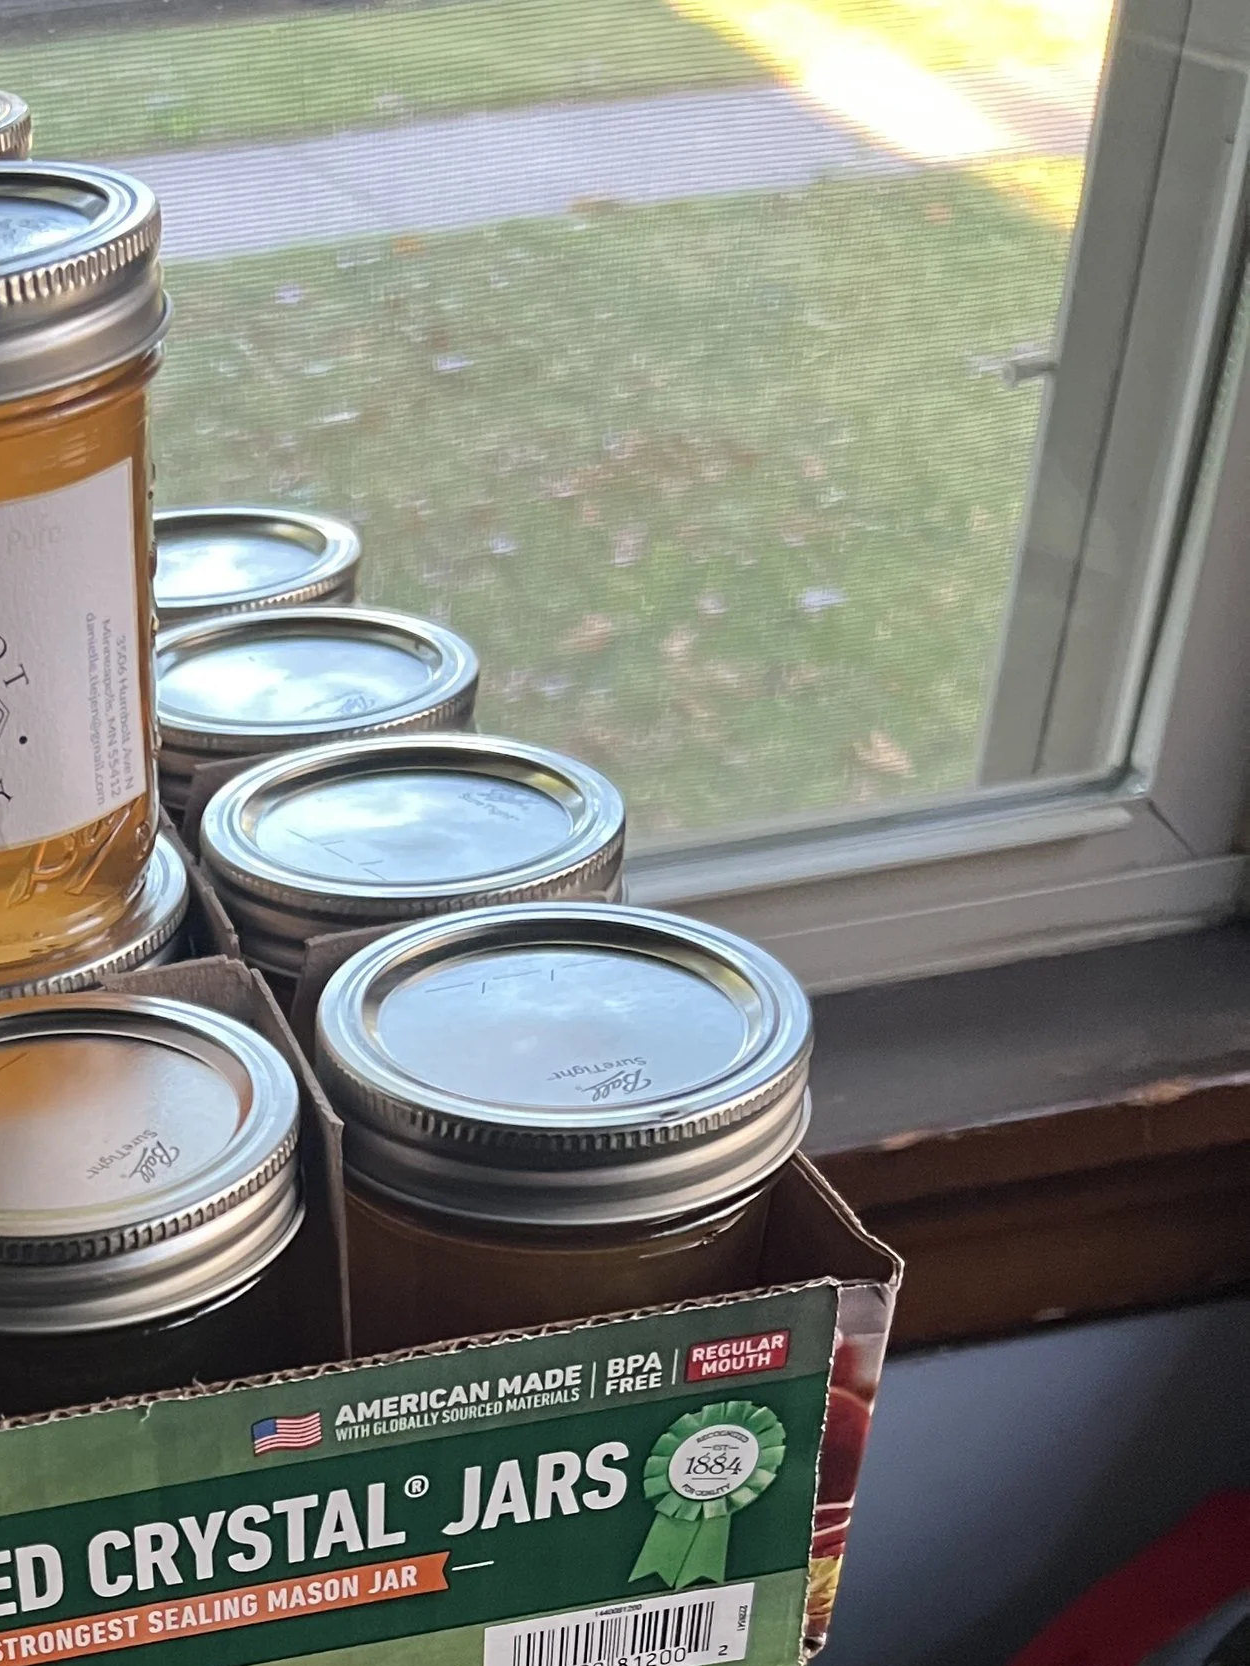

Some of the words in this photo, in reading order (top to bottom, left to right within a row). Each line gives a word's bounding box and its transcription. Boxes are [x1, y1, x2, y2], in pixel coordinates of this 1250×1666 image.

[106, 716, 118, 747] MN
[108, 748, 122, 799] 55412
[581, 1068, 652, 1102] Ball
[129, 1141, 180, 1183] Ball
[692, 1333, 785, 1363] REGULAR
[701, 1351, 772, 1377] MOUTH
[607, 1352, 662, 1379] BPA
[334, 1382, 490, 1426] AMERICAN
[498, 1364, 583, 1396] MADE
[605, 1371, 662, 1397] FREE
[335, 1425, 370, 1442] WITH
[373, 1413, 439, 1437] GLOBALLY
[441, 1401, 503, 1425] SOURCED
[505, 1388, 581, 1413] MATERIALS
[684, 1452, 743, 1476] 1884
[442, 1441, 629, 1537] JARS
[148, 1592, 258, 1635] SEALING
[266, 1575, 361, 1615] MASON
[367, 1565, 418, 1598] JAR
[717, 1644, 729, 1657] 2
